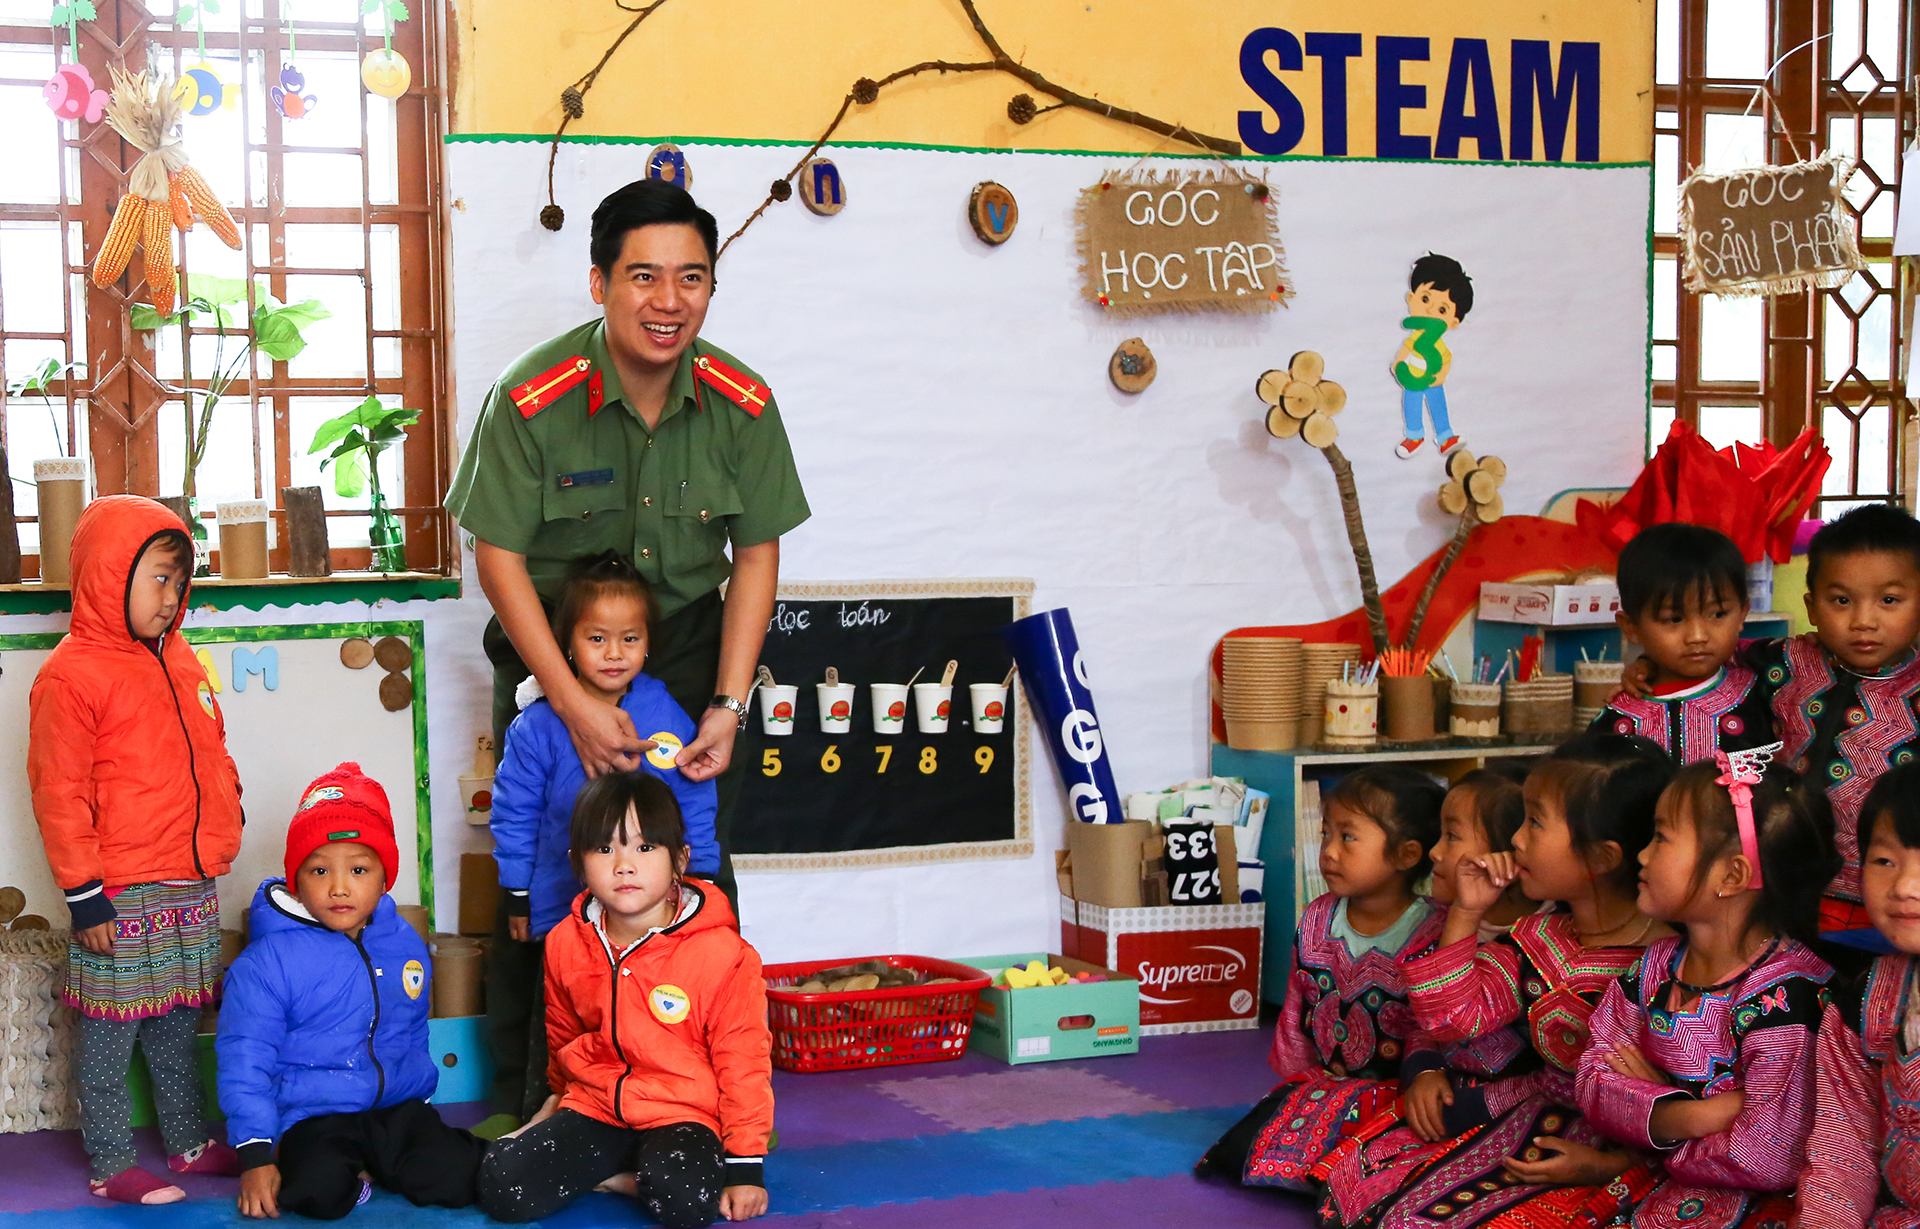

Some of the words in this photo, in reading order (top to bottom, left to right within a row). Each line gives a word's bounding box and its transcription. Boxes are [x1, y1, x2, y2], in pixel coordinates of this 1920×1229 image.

[1238, 27, 1600, 162] STEAM
[813, 164, 841, 205] n
[1125, 176, 1220, 227] GÓC
[1100, 250, 1188, 299] HỌC
[1195, 241, 1277, 296] TẬP
[1699, 218, 1761, 277] SẢN
[1395, 316, 1448, 391] 3
[838, 601, 891, 628] toán
[759, 668, 771, 681] 5
[827, 669, 836, 680] 6
[762, 748, 782, 777] 5
[821, 745, 842, 773] 6
[875, 745, 893, 773] 7
[919, 746, 938, 774] 8
[974, 746, 995, 774] 9
